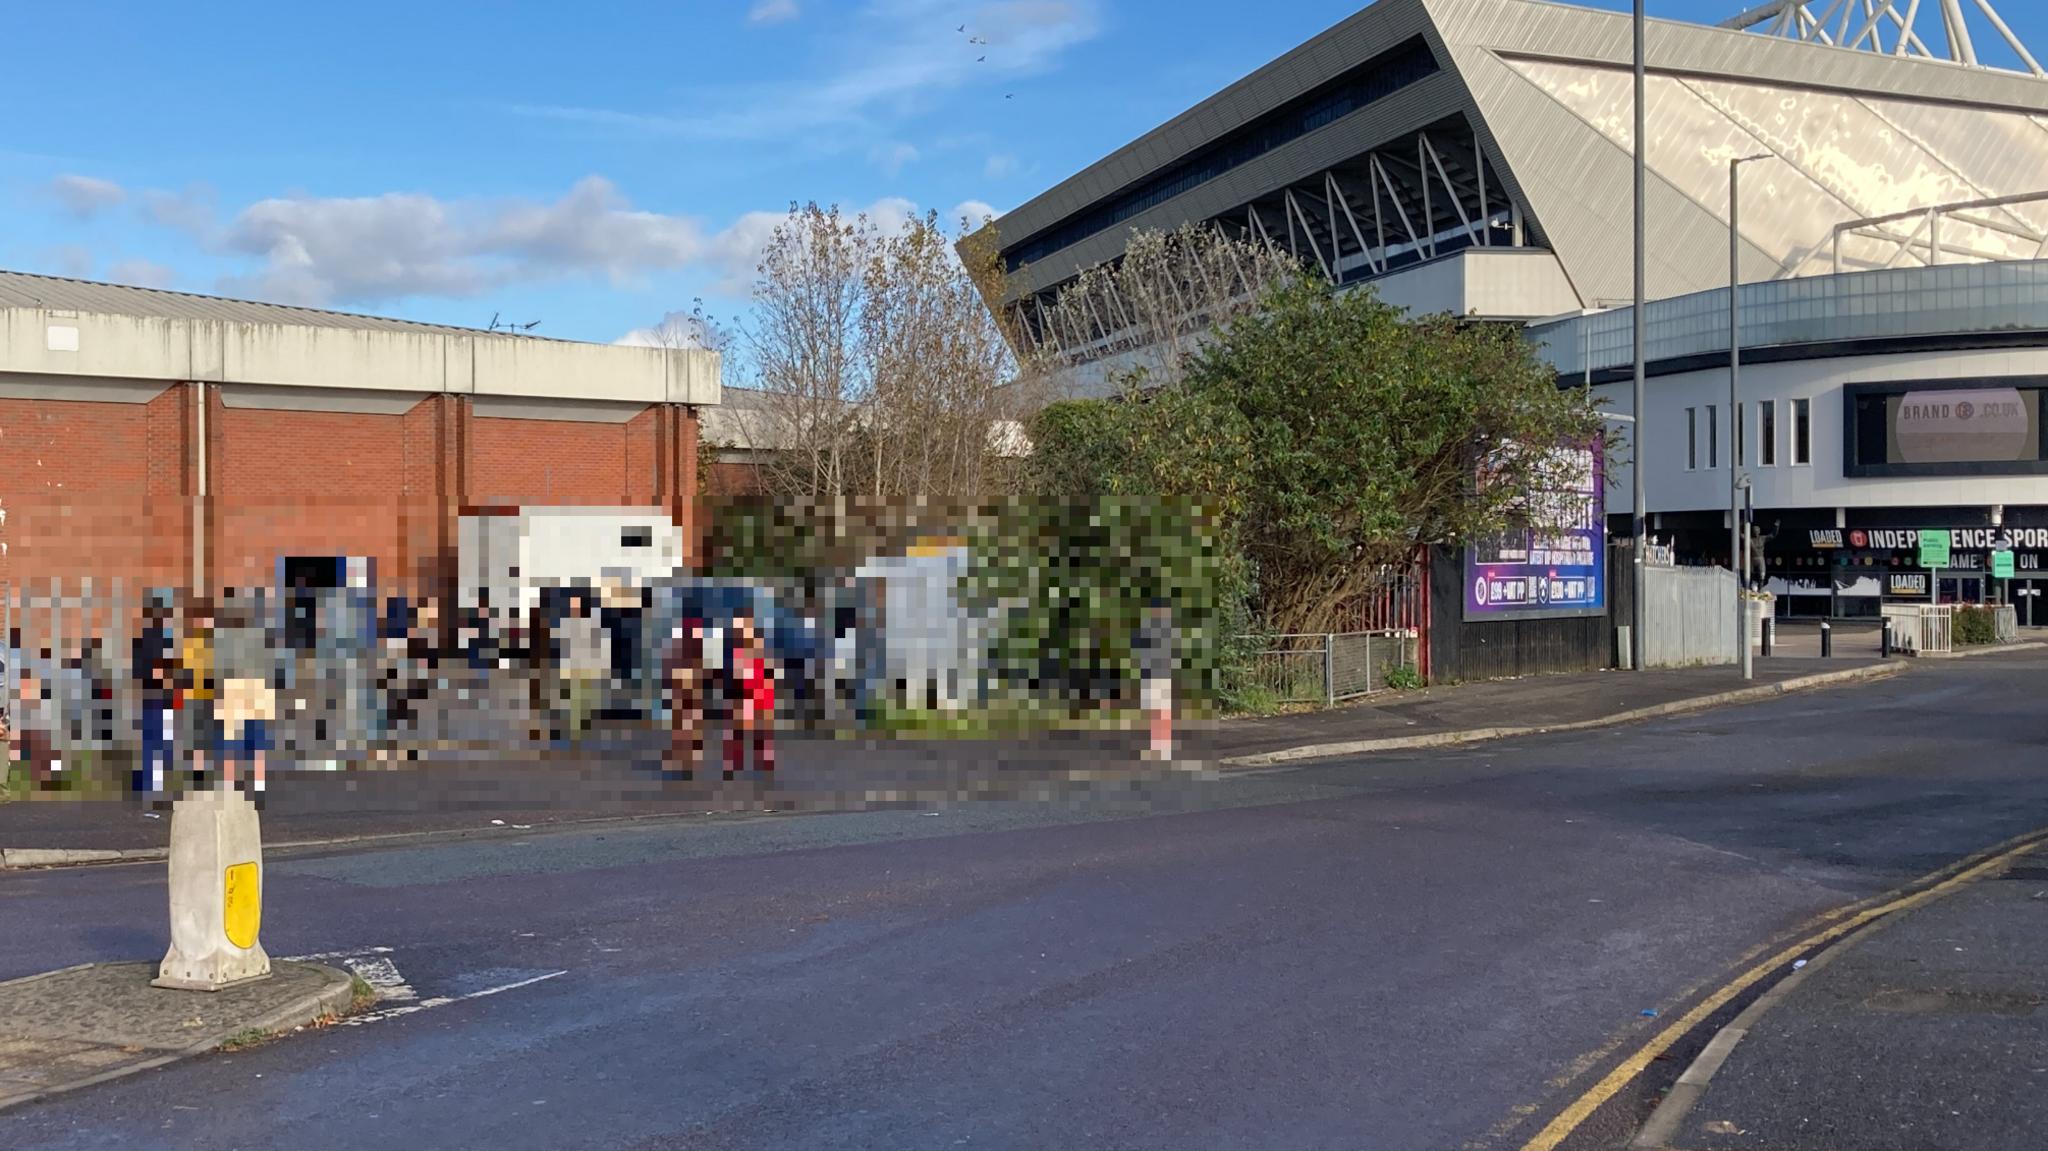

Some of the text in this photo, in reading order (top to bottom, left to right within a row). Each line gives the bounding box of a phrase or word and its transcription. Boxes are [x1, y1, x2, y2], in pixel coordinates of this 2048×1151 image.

[1903, 403, 1949, 420] BRAND
[1809, 530, 1843, 544] LOADED
[1950, 554, 1978, 569] AME
[2020, 554, 2038, 569] ON
[1890, 574, 1925, 589] LOADED
